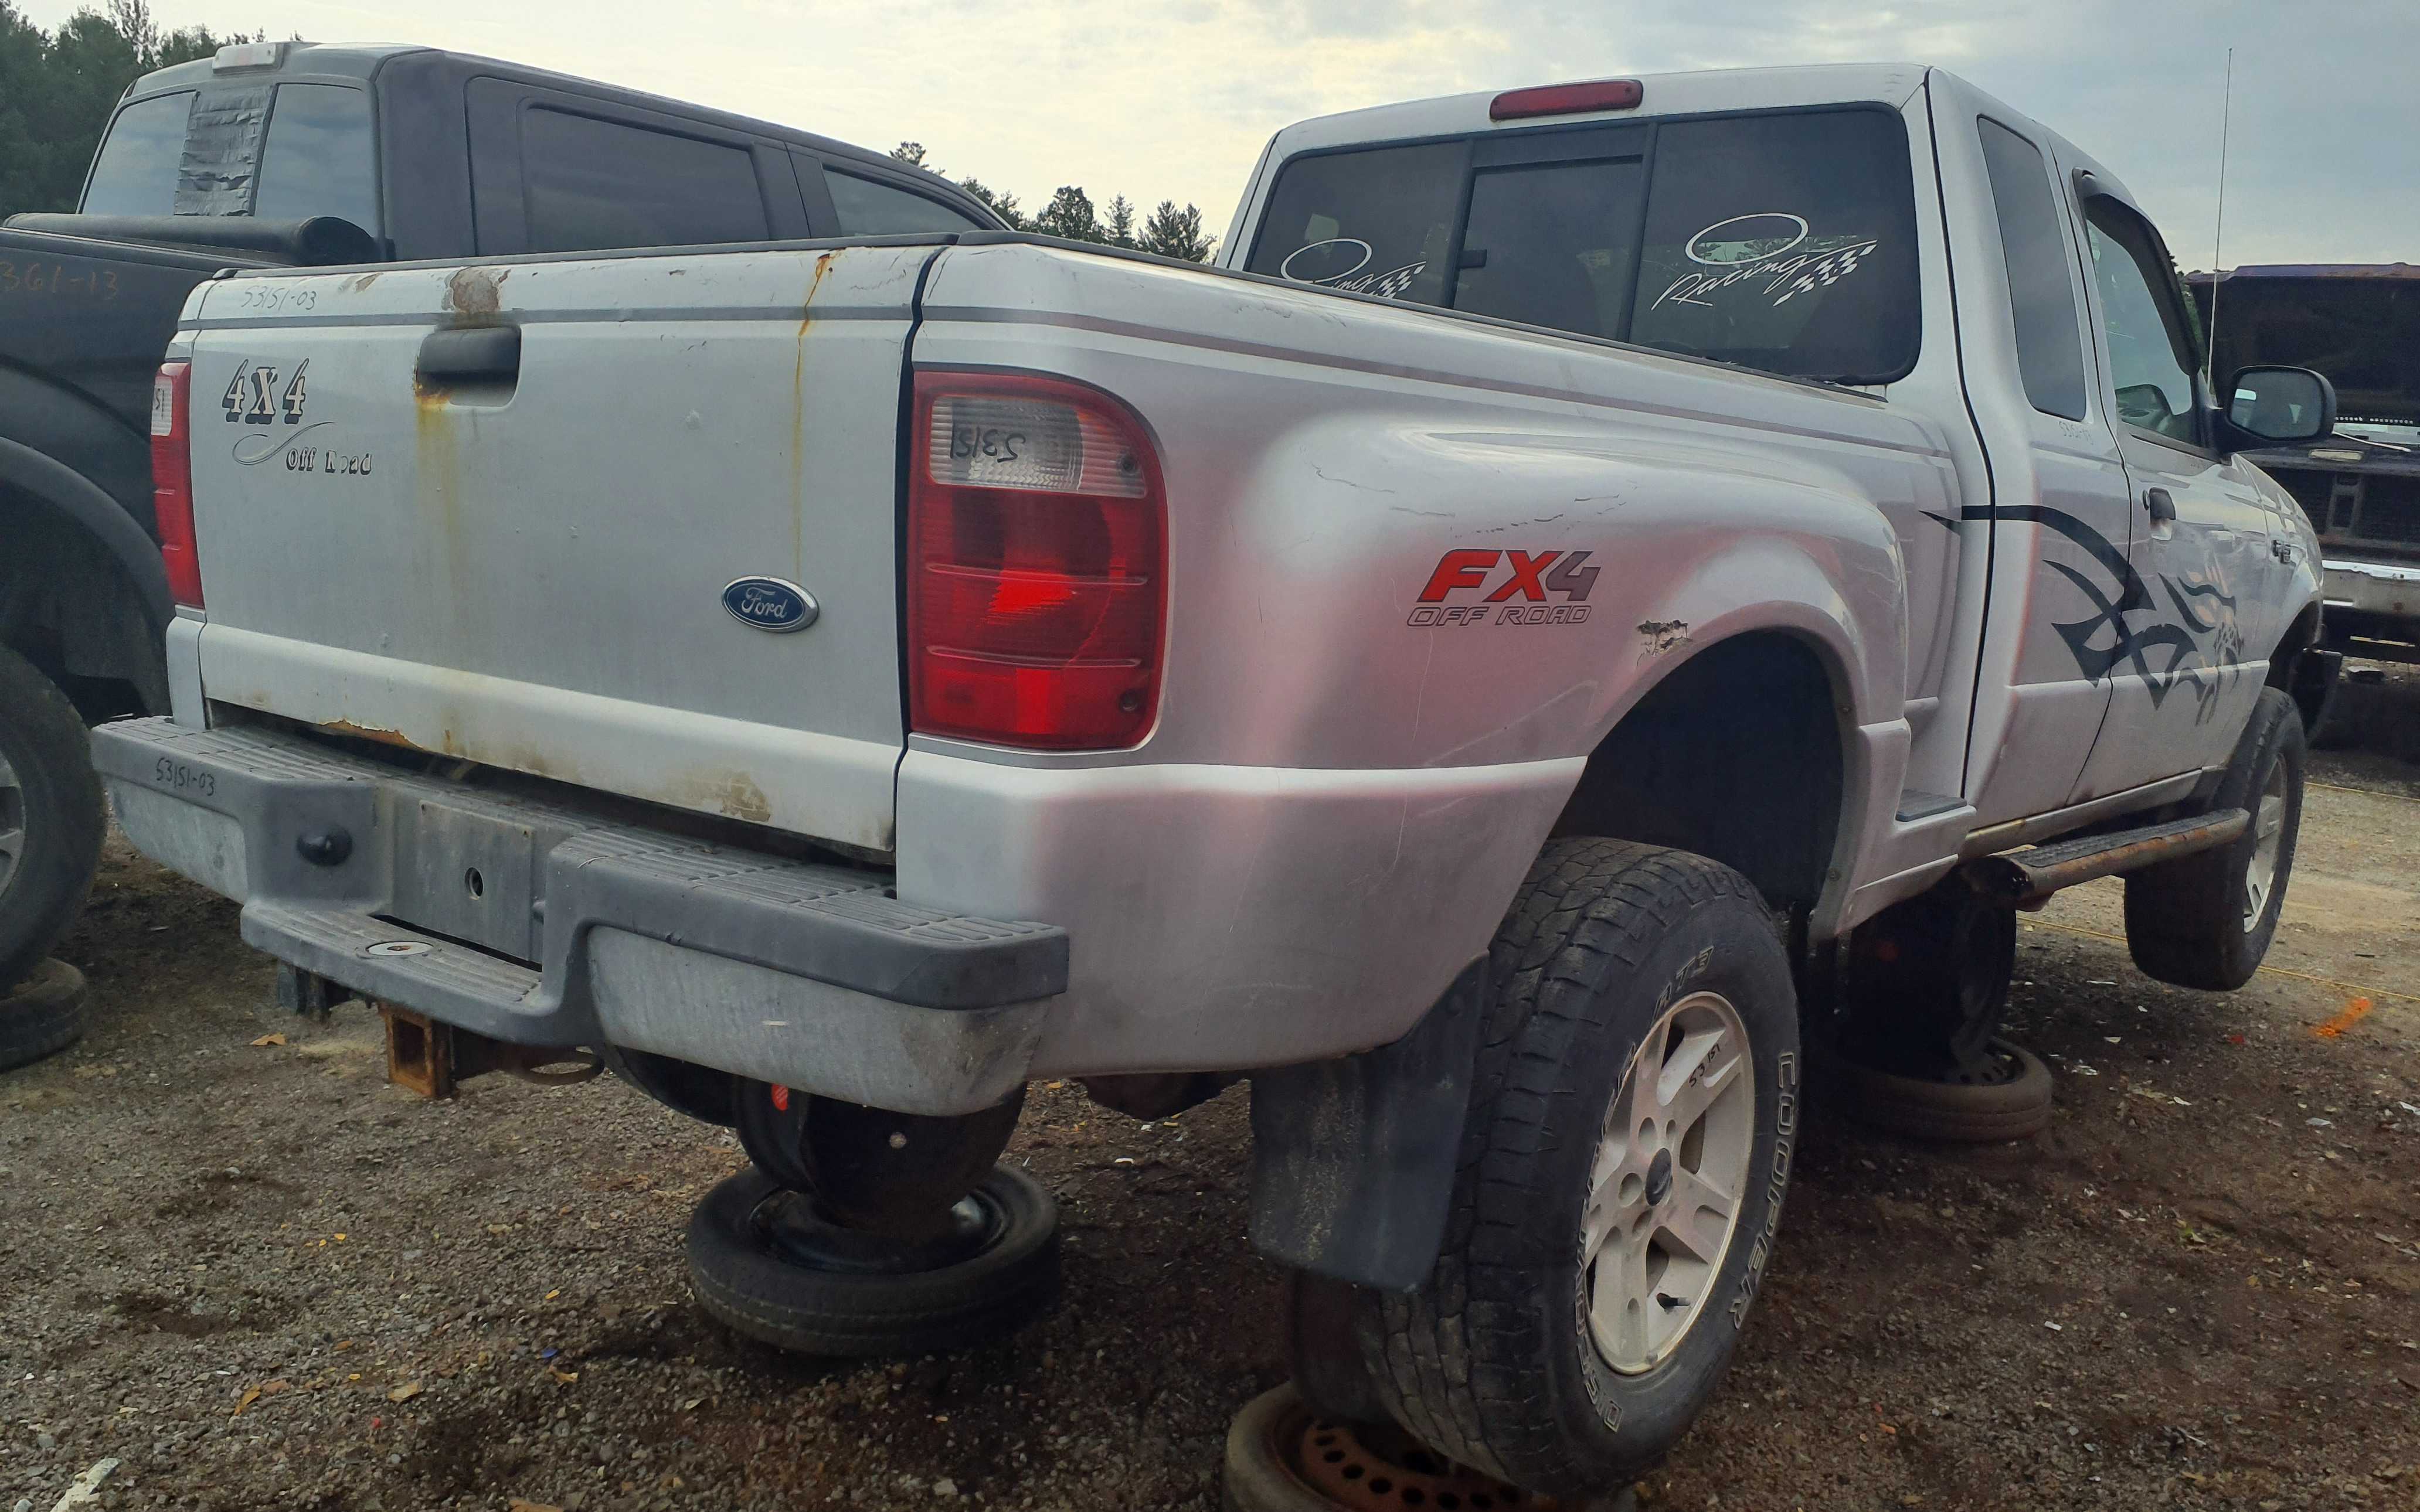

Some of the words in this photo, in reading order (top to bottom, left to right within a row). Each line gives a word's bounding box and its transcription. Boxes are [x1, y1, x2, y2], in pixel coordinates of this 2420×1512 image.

[1650, 253, 1810, 311] Racing
[286, 447, 317, 471] Off
[1416, 549, 1602, 602] FX4
[741, 587, 788, 619] Ford
[1407, 606, 1490, 627] OFF
[1495, 605, 1592, 625] ROAD
[1729, 1052, 1795, 1330] COOPER
